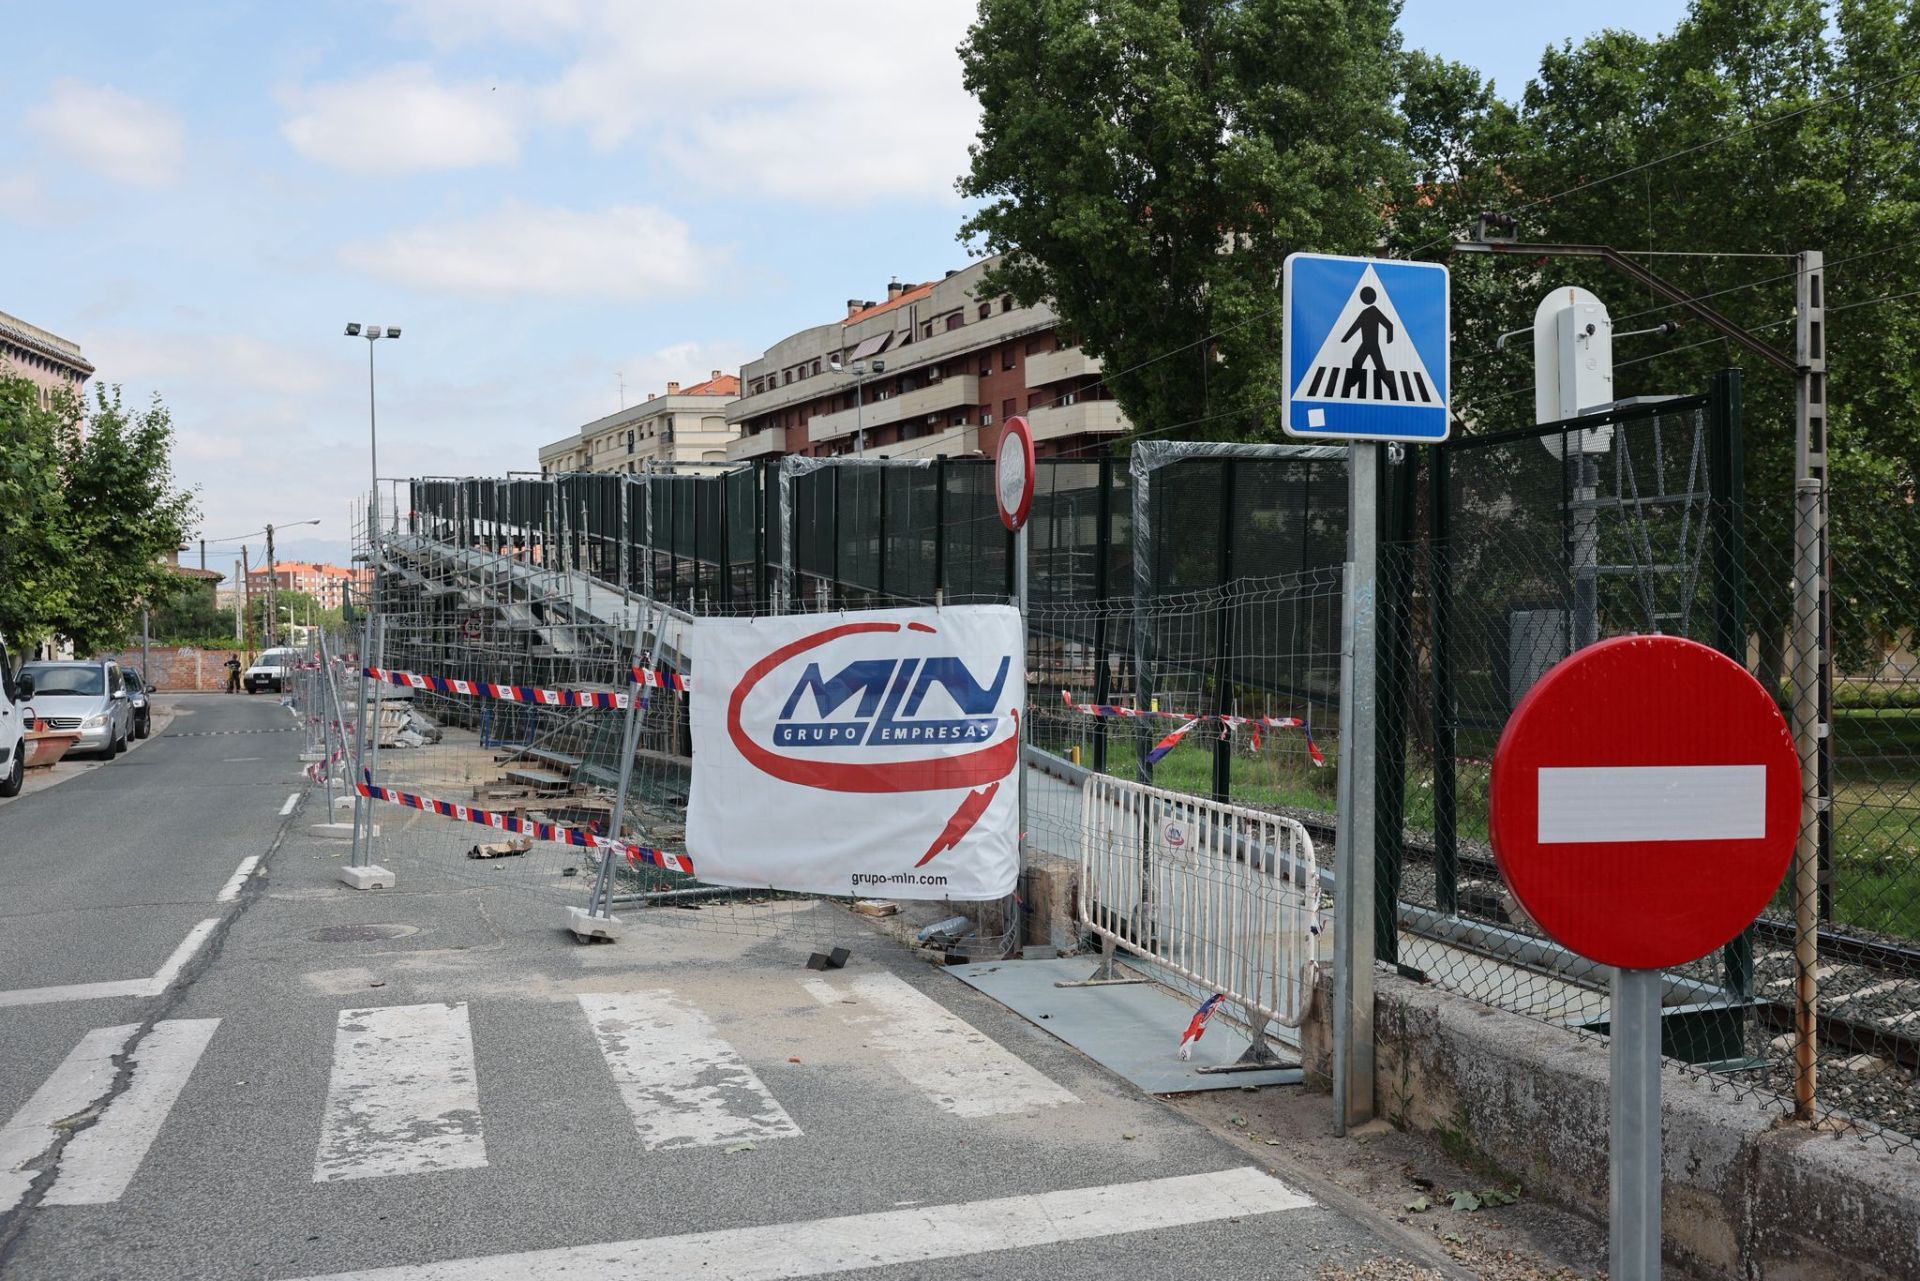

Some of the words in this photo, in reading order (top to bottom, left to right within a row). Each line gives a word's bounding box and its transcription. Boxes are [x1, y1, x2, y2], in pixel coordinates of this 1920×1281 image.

[778, 655, 1011, 721] MLN
[783, 727, 856, 741] GRUPO
[881, 724, 990, 741] EMPRESAS
[851, 872, 948, 886] grupo-mln.com
